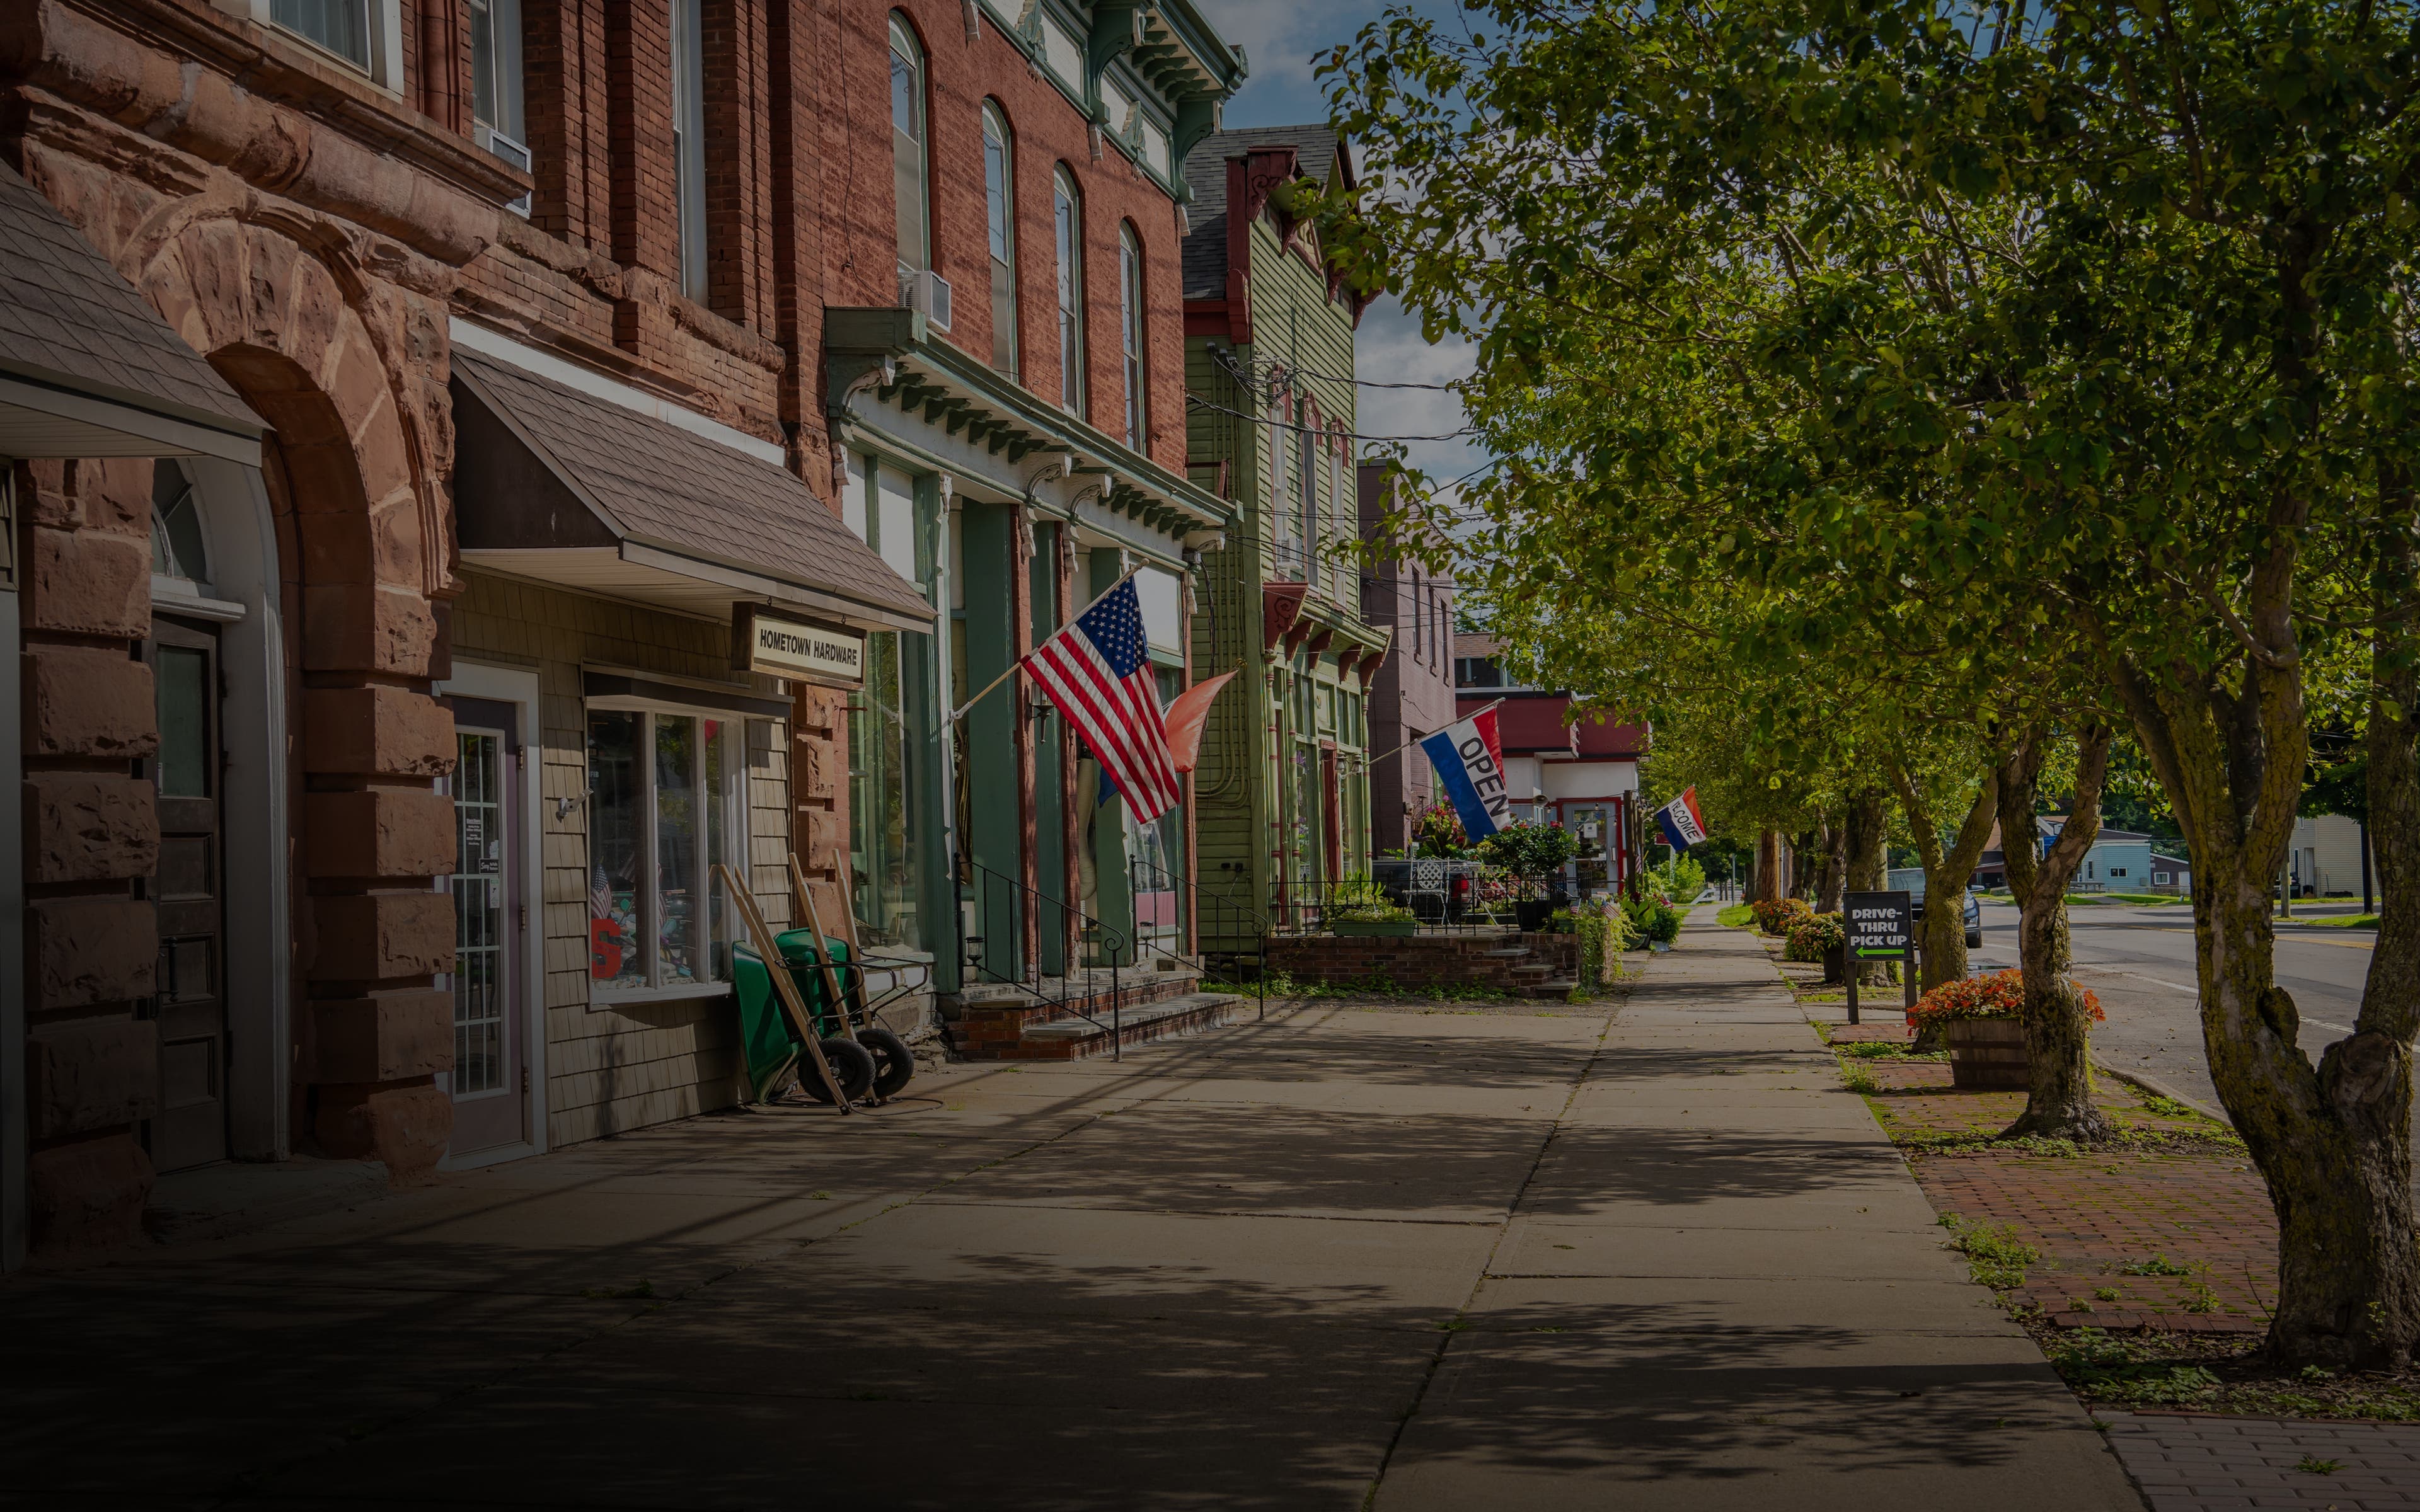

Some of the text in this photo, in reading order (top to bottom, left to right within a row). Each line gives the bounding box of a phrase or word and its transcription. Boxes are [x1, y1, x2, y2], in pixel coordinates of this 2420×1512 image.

[760, 629, 857, 666] HOMETOWN HARDWARE
[1459, 737, 1509, 817] OPEN
[1850, 935, 1907, 946] PICK UP
